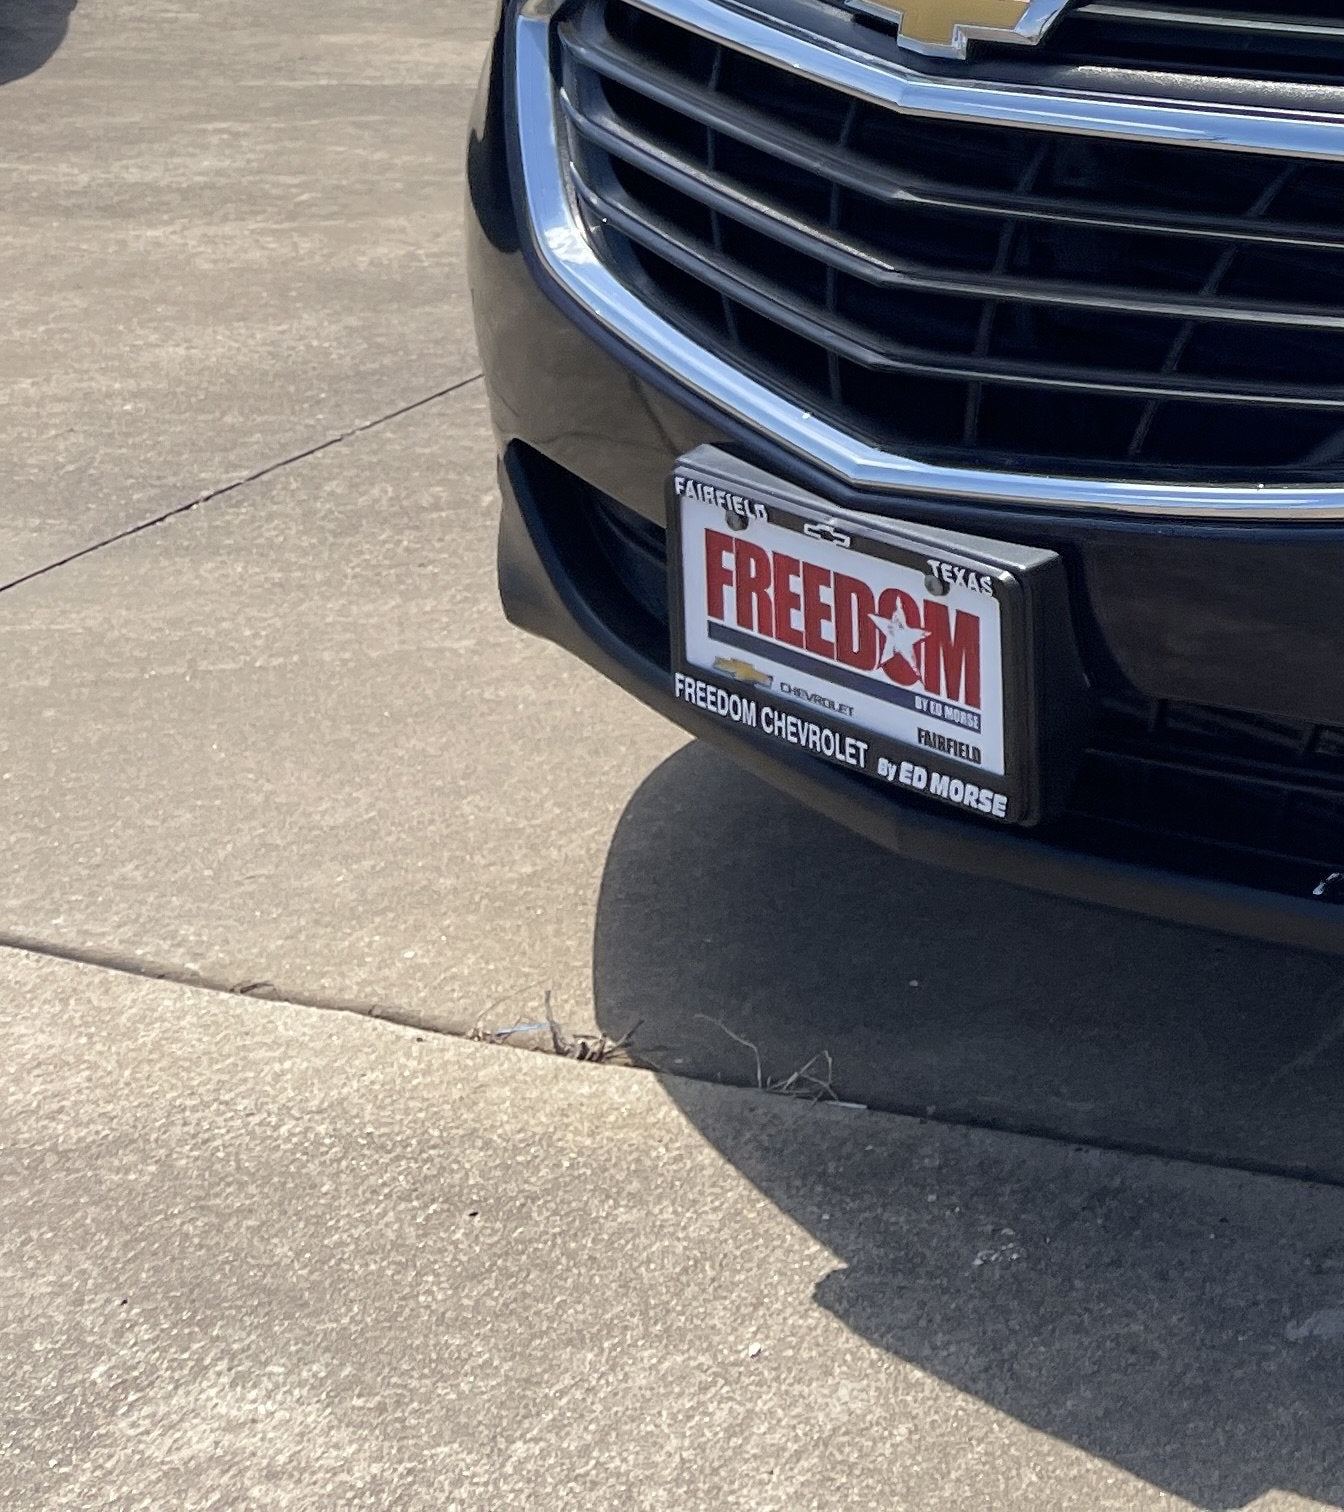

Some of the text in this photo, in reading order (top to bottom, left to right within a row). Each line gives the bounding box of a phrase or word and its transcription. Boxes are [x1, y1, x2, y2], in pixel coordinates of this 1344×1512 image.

[674, 476, 994, 598] FAIRFIELD TEXAS
[704, 527, 981, 710] FREEDOM
[779, 681, 855, 717] CHEVROLET
[915, 695, 980, 730] BY ED MORSE
[674, 671, 757, 728] FREEDOM
[760, 706, 869, 768] CHEVROLET
[899, 761, 928, 789] ED
[930, 772, 1008, 818] MORSE
[917, 727, 982, 765] FAIRFIELD
